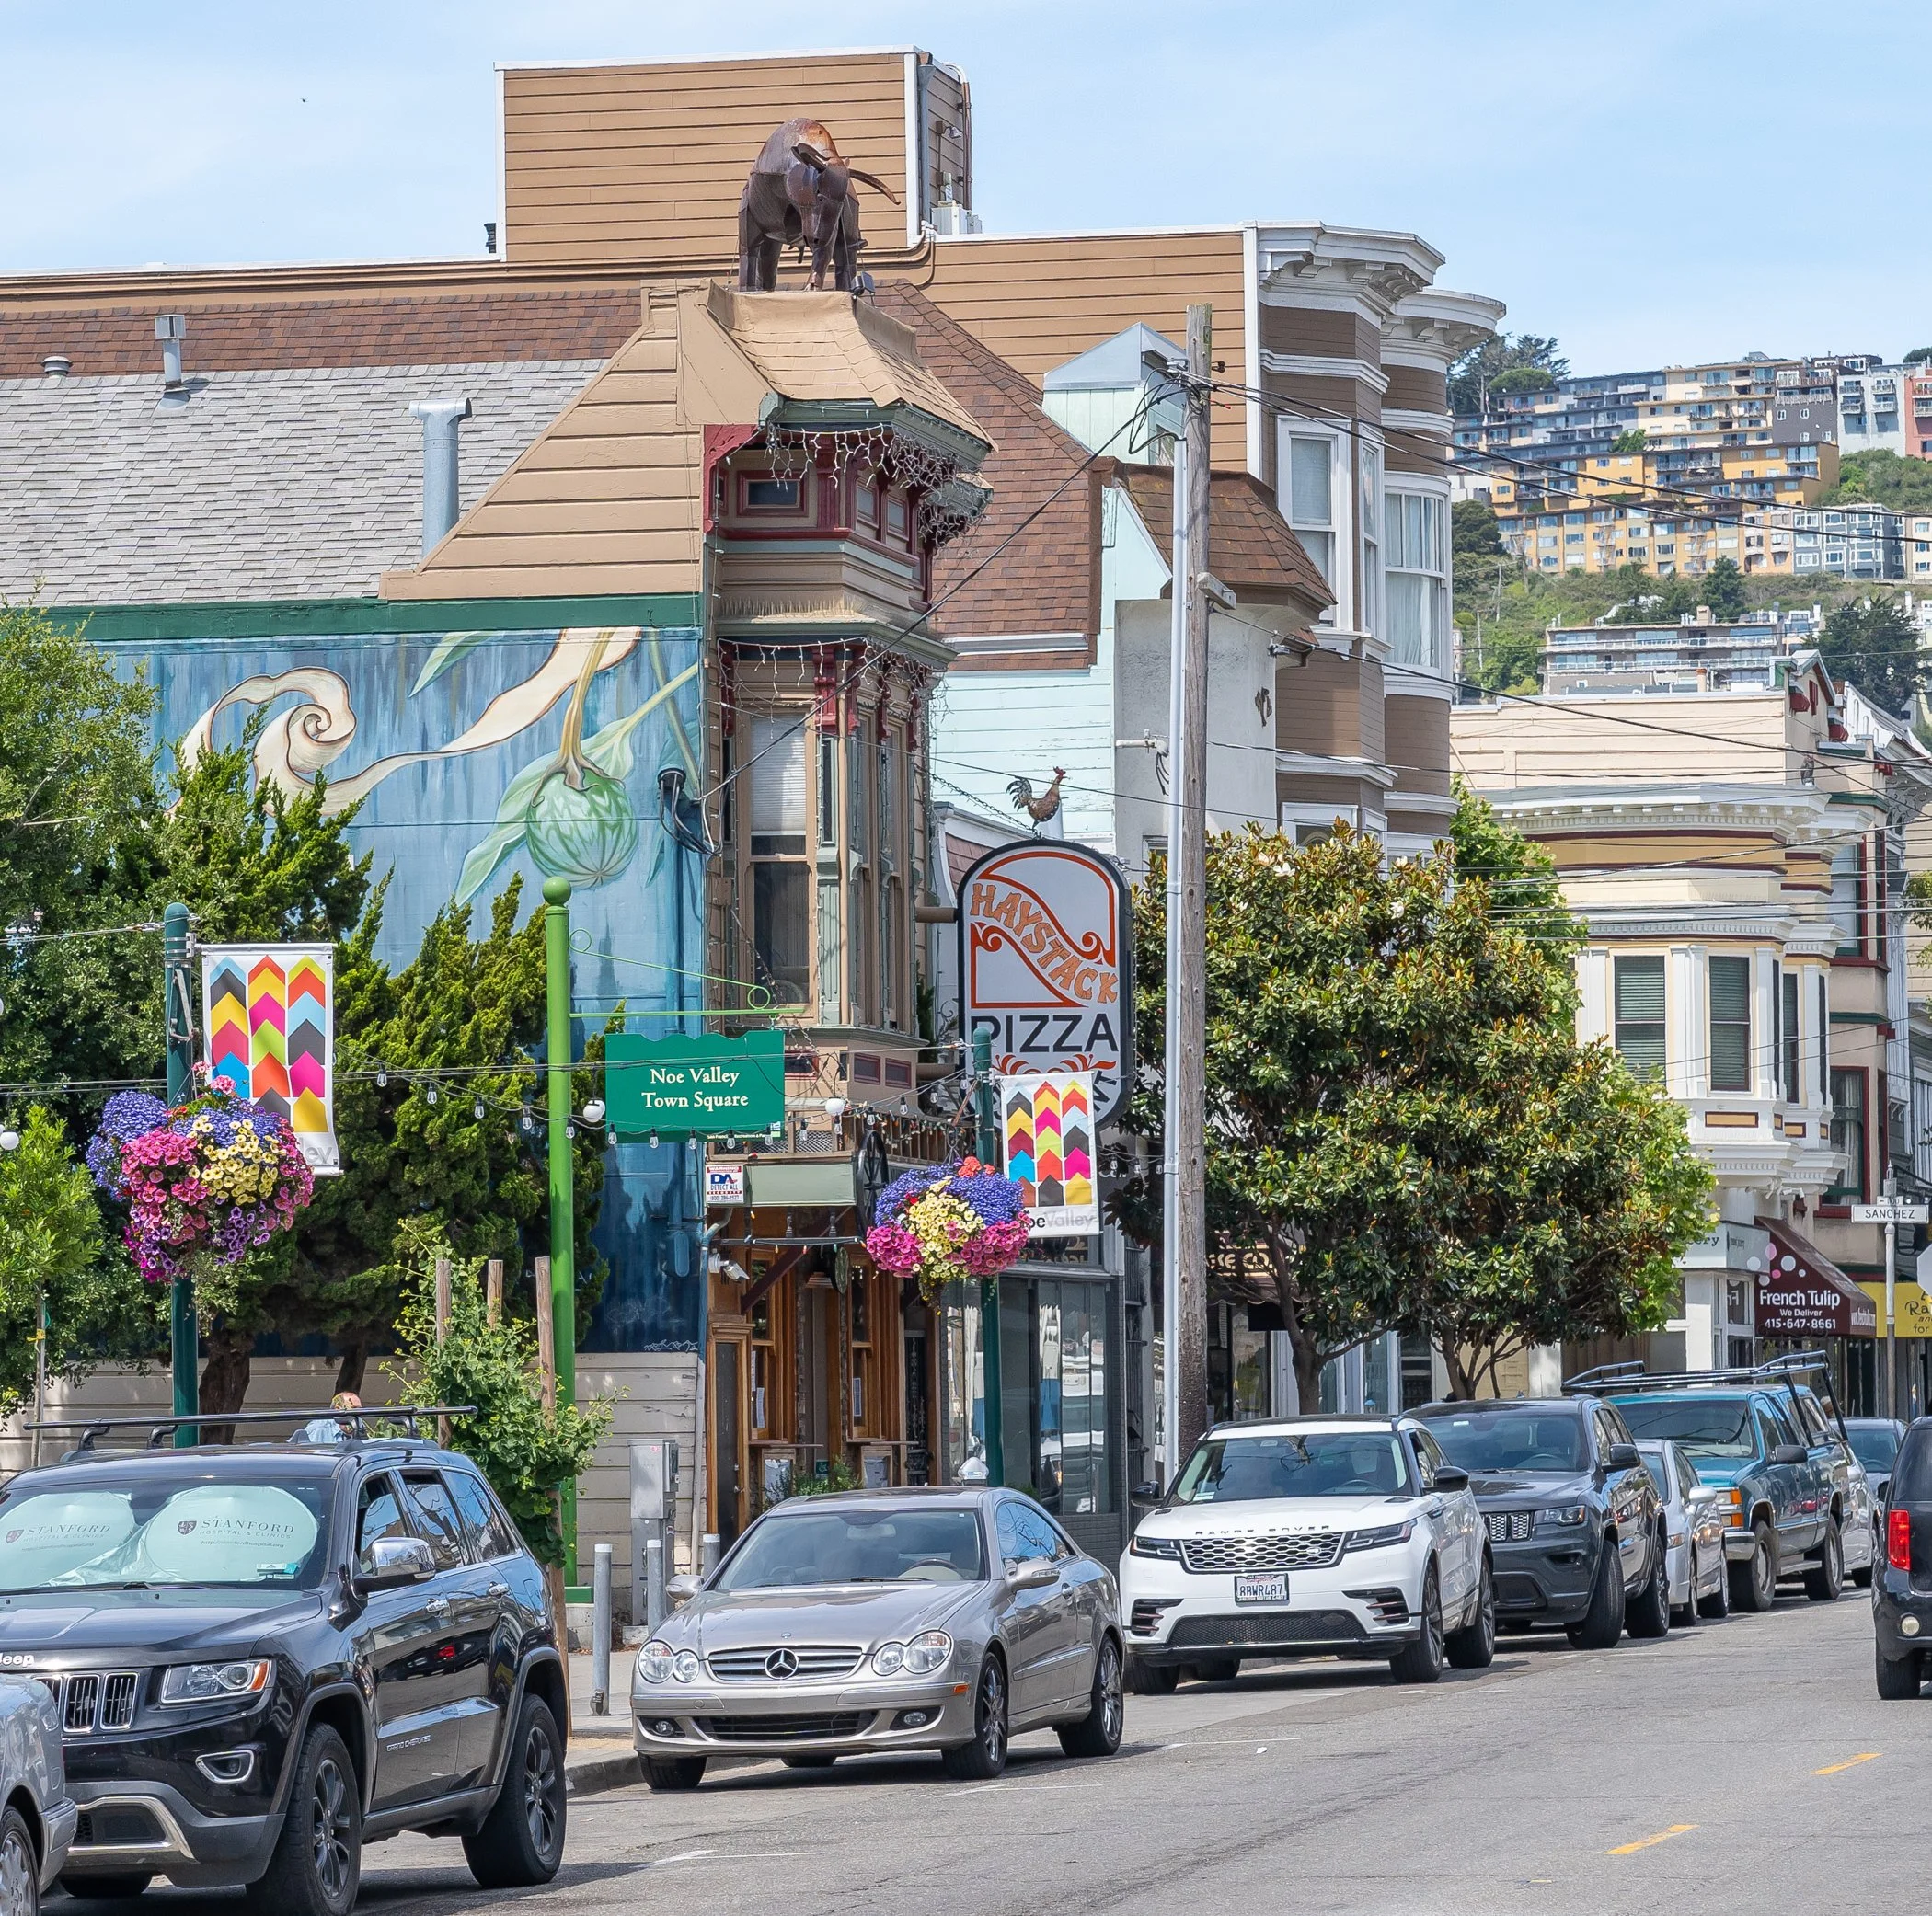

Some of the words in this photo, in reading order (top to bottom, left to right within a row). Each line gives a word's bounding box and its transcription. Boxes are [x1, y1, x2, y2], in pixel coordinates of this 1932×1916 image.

[970, 883, 1119, 1004] HAYSTACK
[971, 1013, 1119, 1053] PIZZA
[650, 1068, 685, 1084] Noe
[690, 1066, 740, 1087] Valley
[641, 1092, 689, 1108] Town
[694, 1091, 749, 1112] Square
[710, 1174, 736, 1184] DA
[1865, 1209, 1915, 1219] SANCHEZ
[1759, 1289, 1805, 1306] French
[1808, 1290, 1840, 1310] Tulip
[1779, 1308, 1792, 1316] We
[1794, 1308, 1823, 1316] Deliver
[1914, 1324, 1929, 1334] for
[28, 1524, 111, 1535] STANFORD
[201, 1519, 295, 1533] STANFORD
